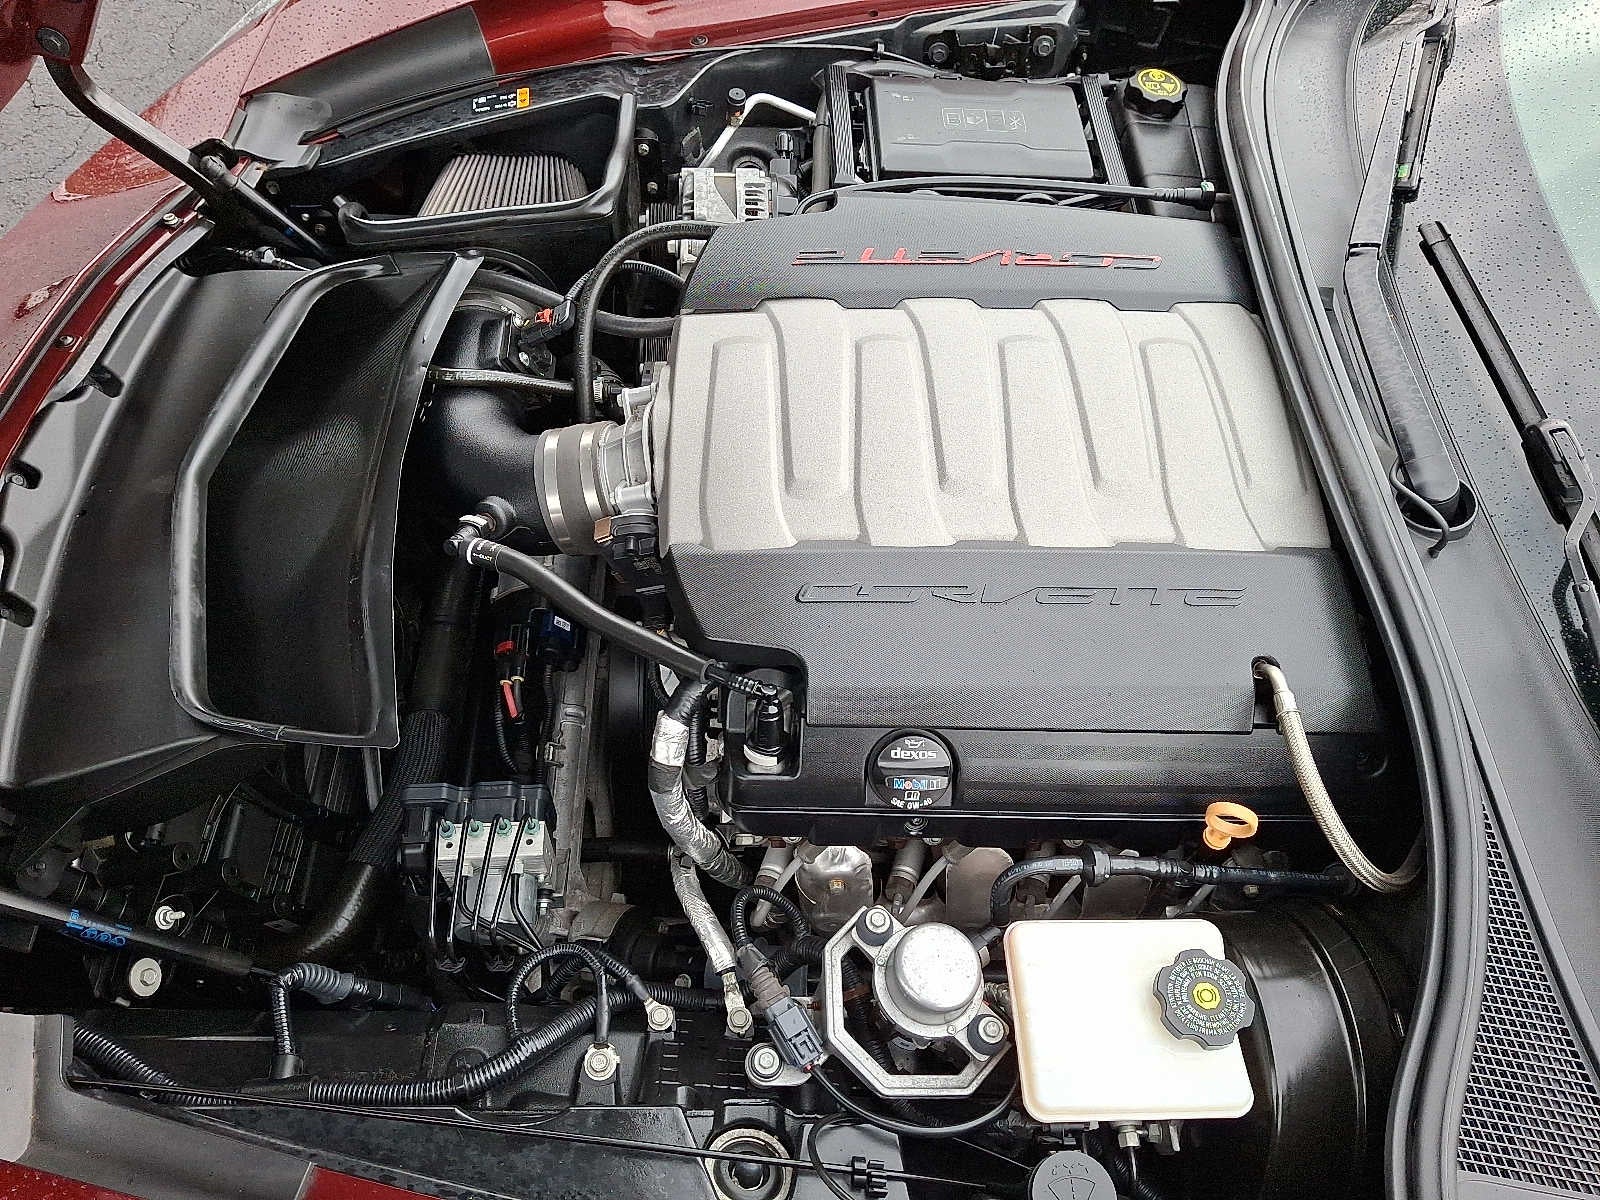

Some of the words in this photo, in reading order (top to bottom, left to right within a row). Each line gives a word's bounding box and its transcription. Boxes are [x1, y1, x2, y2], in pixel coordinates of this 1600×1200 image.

[795, 582, 1249, 608] CORVETTE
[890, 747, 938, 759] dexos
[893, 778, 927, 789] Mobil
[890, 797, 905, 808] SAE
